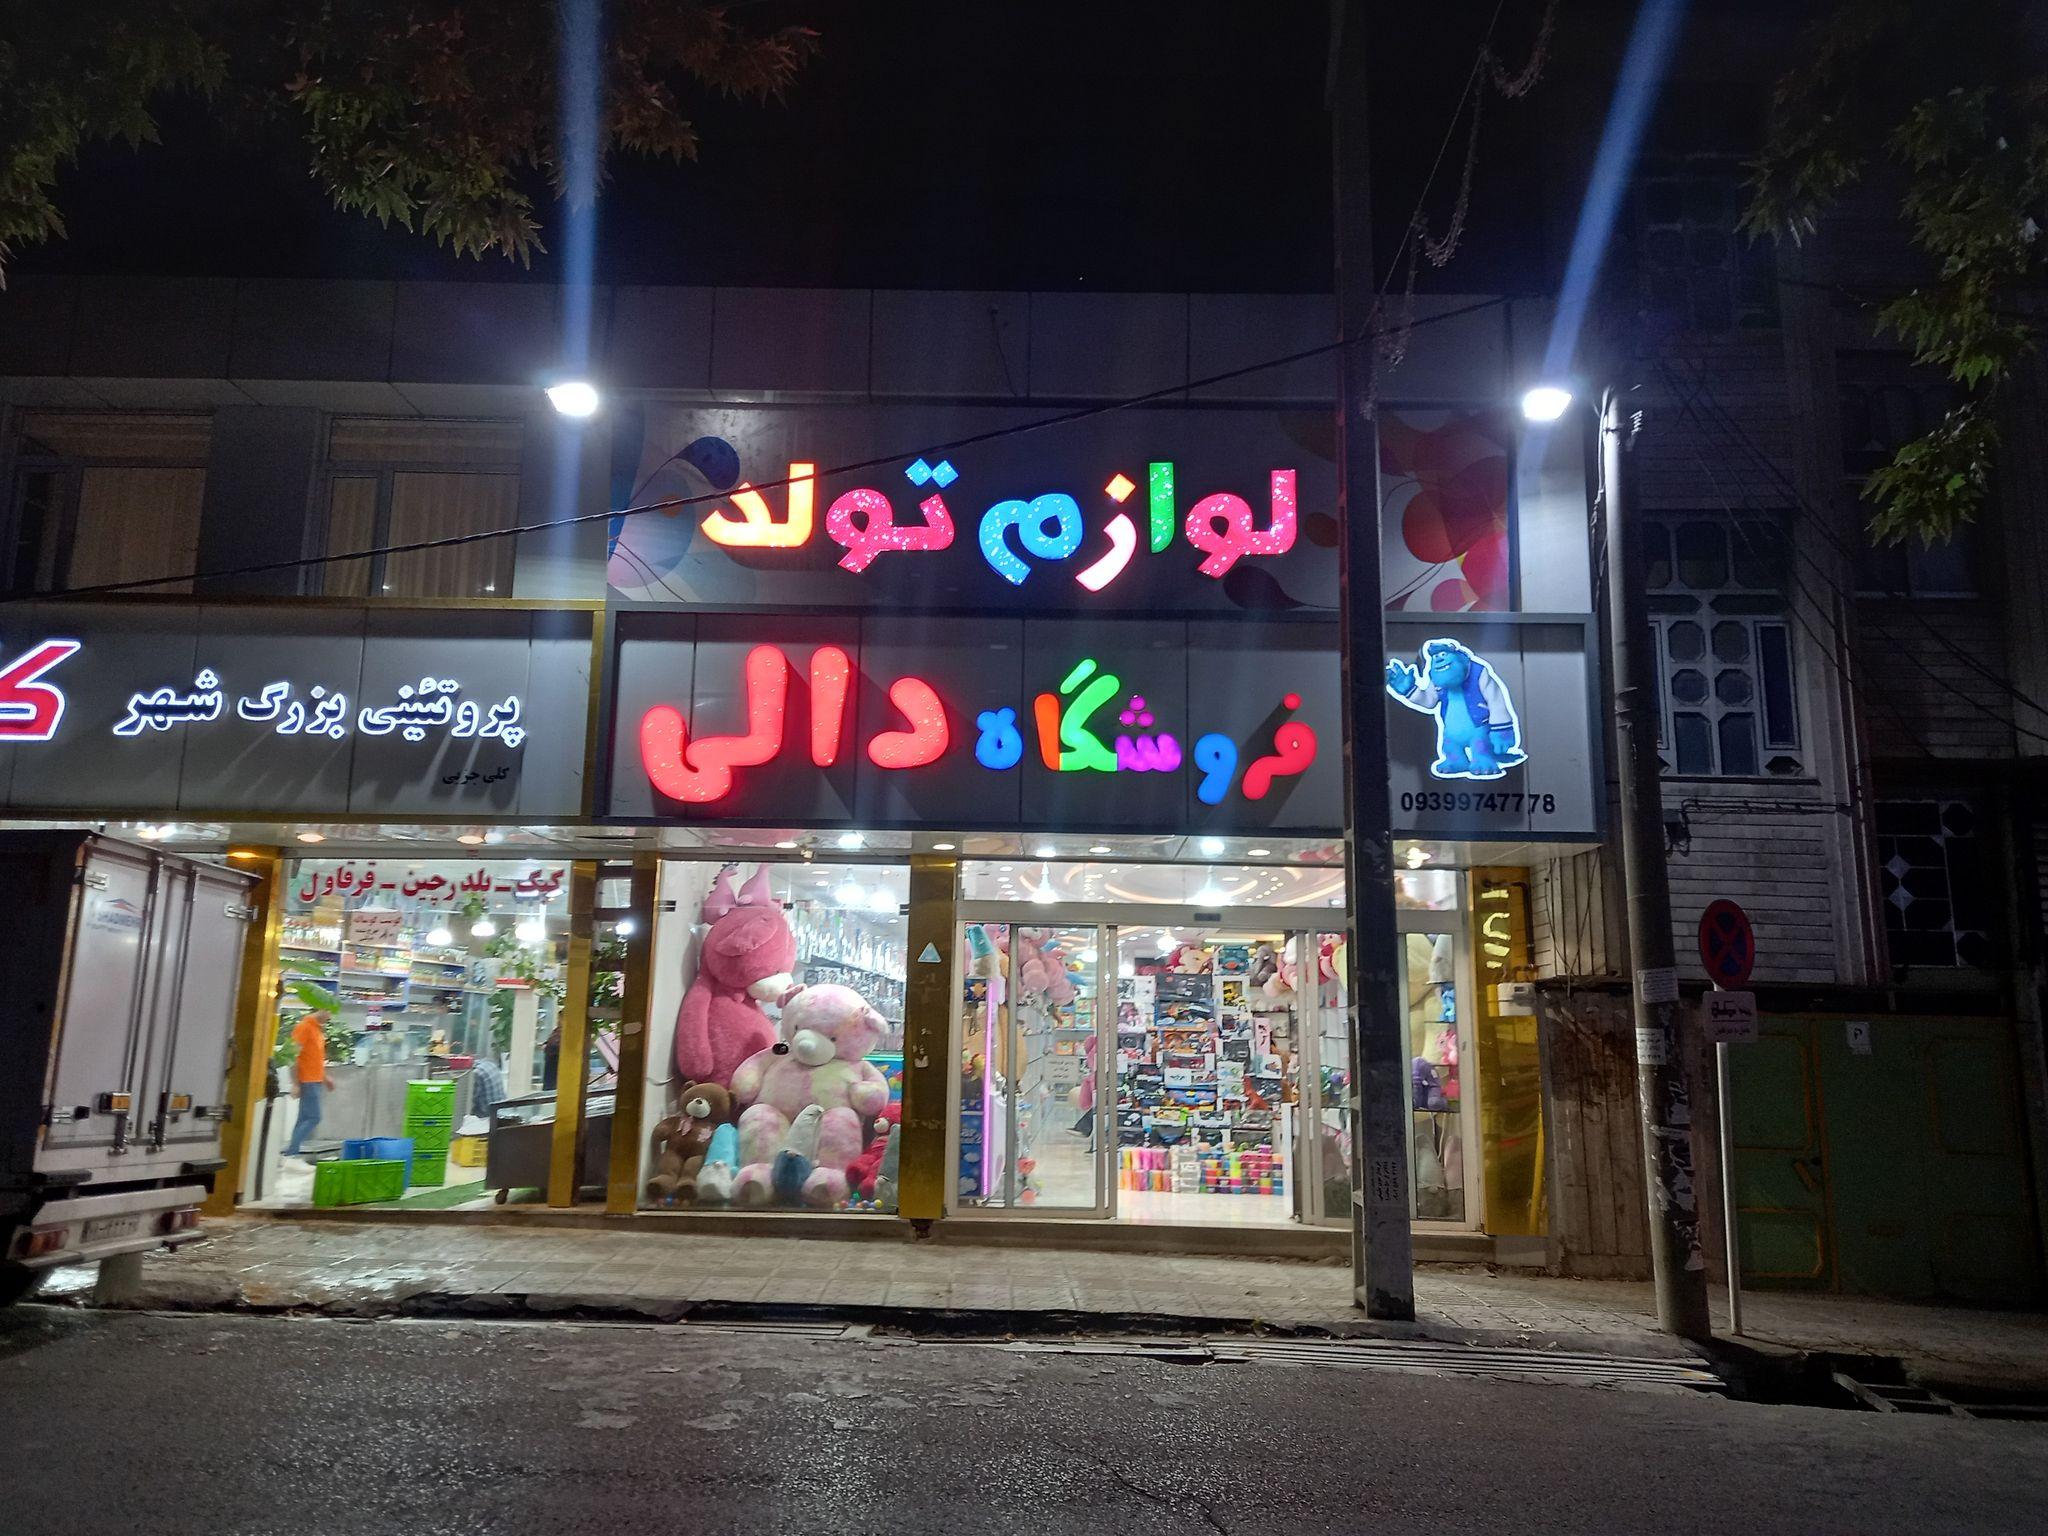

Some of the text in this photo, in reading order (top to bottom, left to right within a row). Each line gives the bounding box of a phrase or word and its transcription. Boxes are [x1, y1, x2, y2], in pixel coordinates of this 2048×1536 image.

[701, 457, 1297, 592] لوازم تولد
[113, 669, 526, 749] پروتئینی بزرگ شهر
[640, 643, 1318, 806] فروشگاه دالی
[483, 766, 510, 784] کلی
[1400, 791, 1556, 815] 09399747778
[299, 860, 376, 903] قرقاول
[402, 867, 491, 906] بلدرچین
